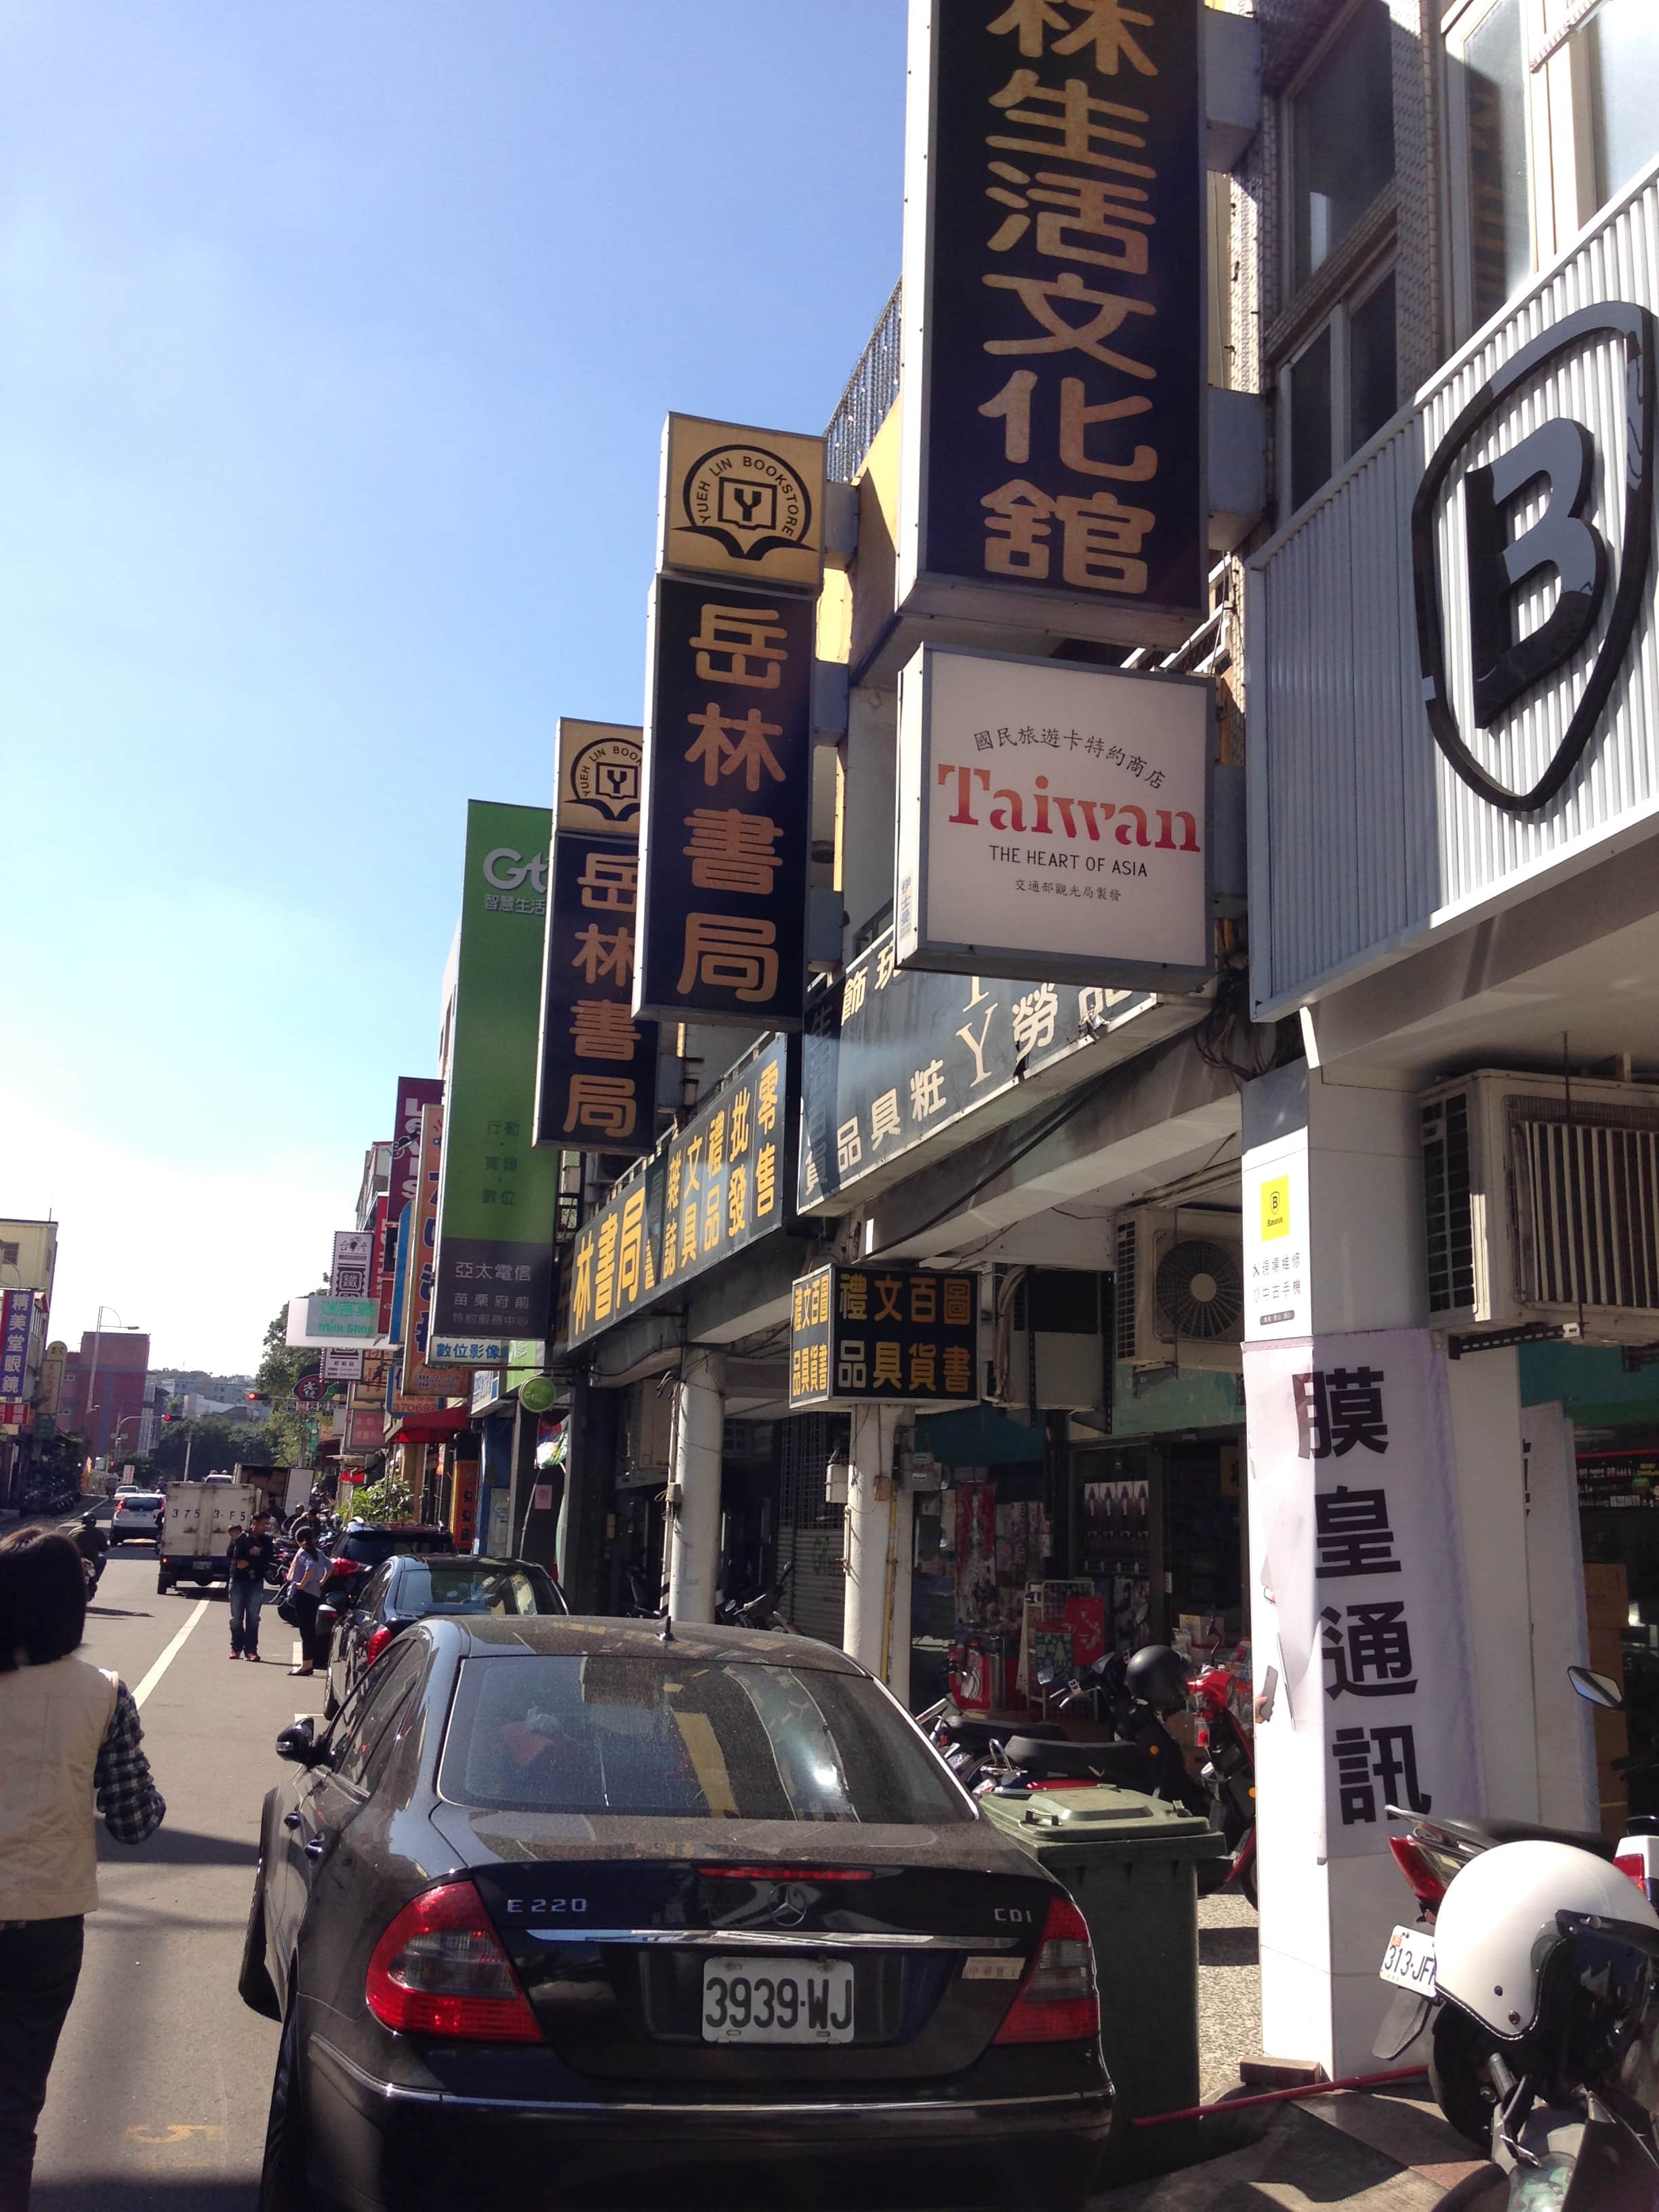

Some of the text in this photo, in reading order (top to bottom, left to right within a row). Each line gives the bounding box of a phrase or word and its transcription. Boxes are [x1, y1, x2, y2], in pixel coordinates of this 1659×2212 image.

[696, 455, 800, 537] YUEH LIN BOOKSTORE
[580, 765, 591, 797] YUEH
[589, 748, 606, 762] LIN
[973, 726, 1166, 790] 國民旅遊卡特約商店
[683, 603, 790, 1002] 岳林書局
[937, 764, 1201, 853] Taiwan
[989, 845, 1149, 877] THE HEART OF ASIA
[563, 852, 641, 1138] 岳林書局
[454, 1292, 529, 1309] 苗栗府前
[455, 1261, 531, 1282] 亞太電信
[1292, 1366, 1432, 1825] 膜皇通訊
[994, 1908, 1031, 1923] CDI
